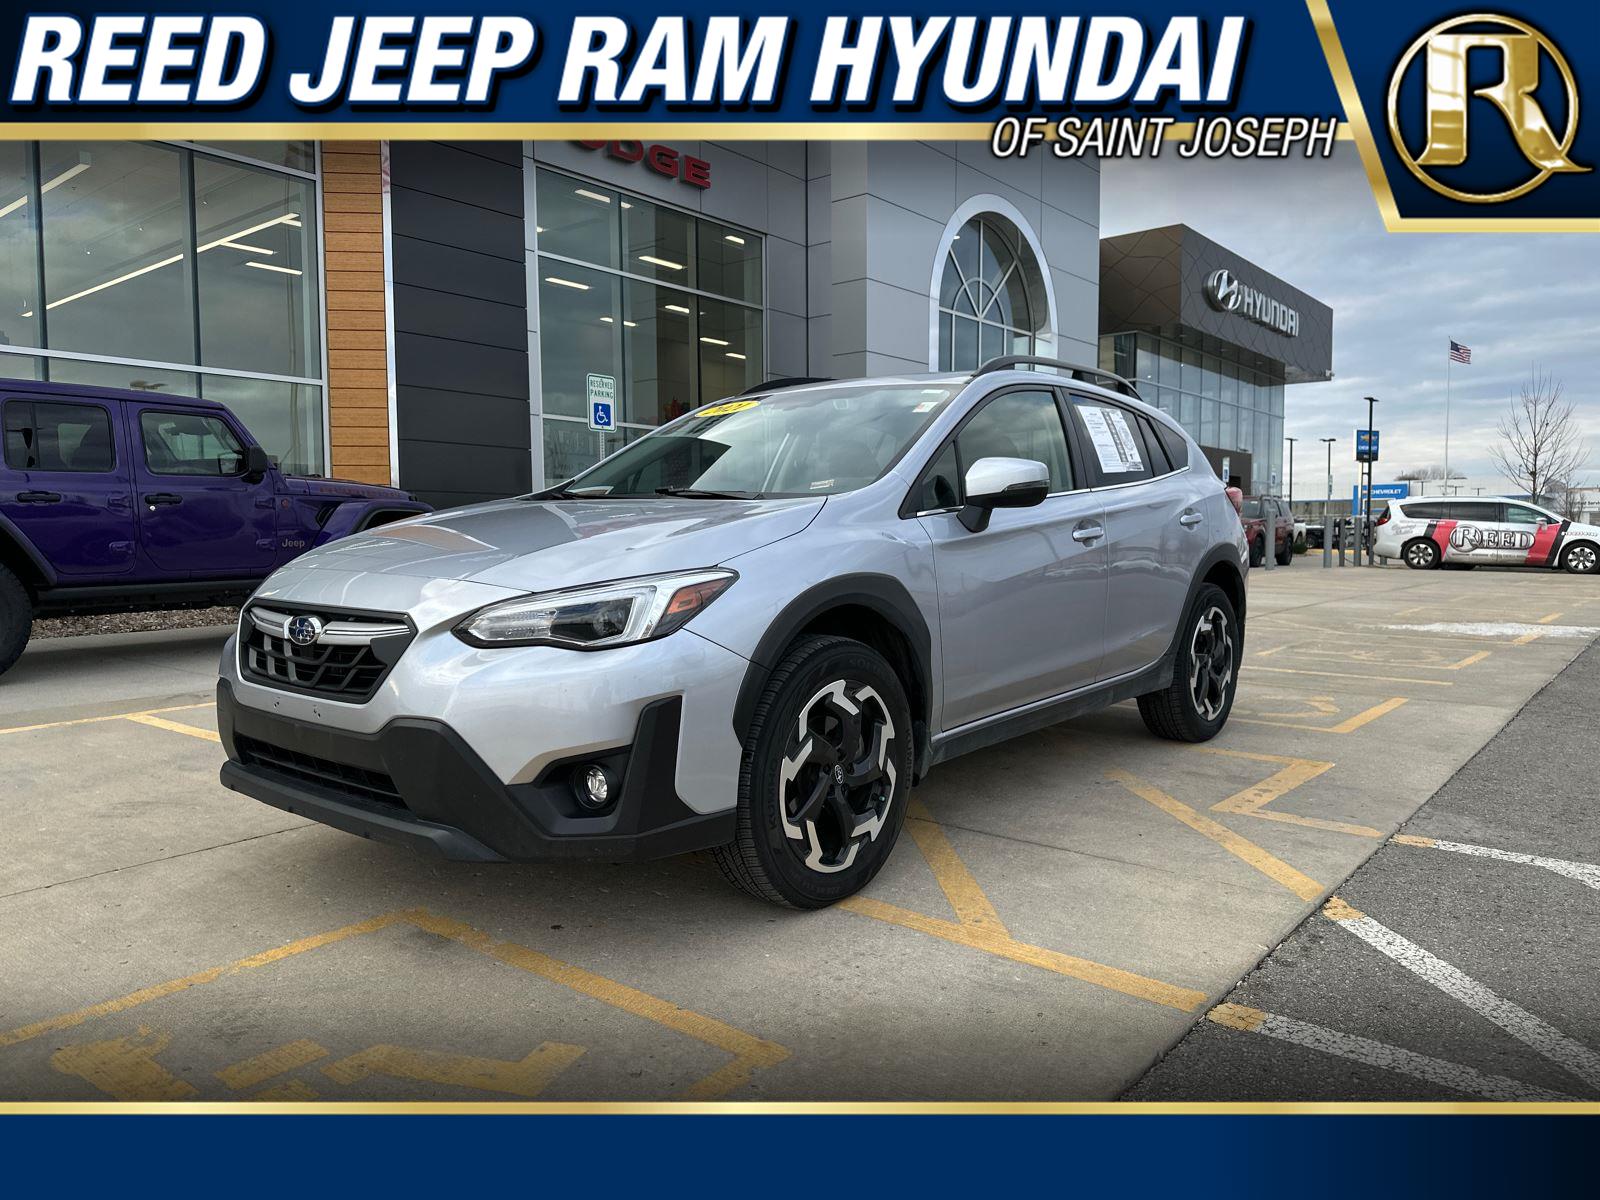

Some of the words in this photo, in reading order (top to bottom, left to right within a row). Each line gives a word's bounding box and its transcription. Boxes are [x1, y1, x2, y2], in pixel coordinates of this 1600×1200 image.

[1241, 285, 1299, 337] HYUNDAI
[589, 379, 613, 390] RESERVED
[590, 389, 614, 399] PARKING
[281, 538, 305, 549] Jeep
[1451, 525, 1535, 551] REED
